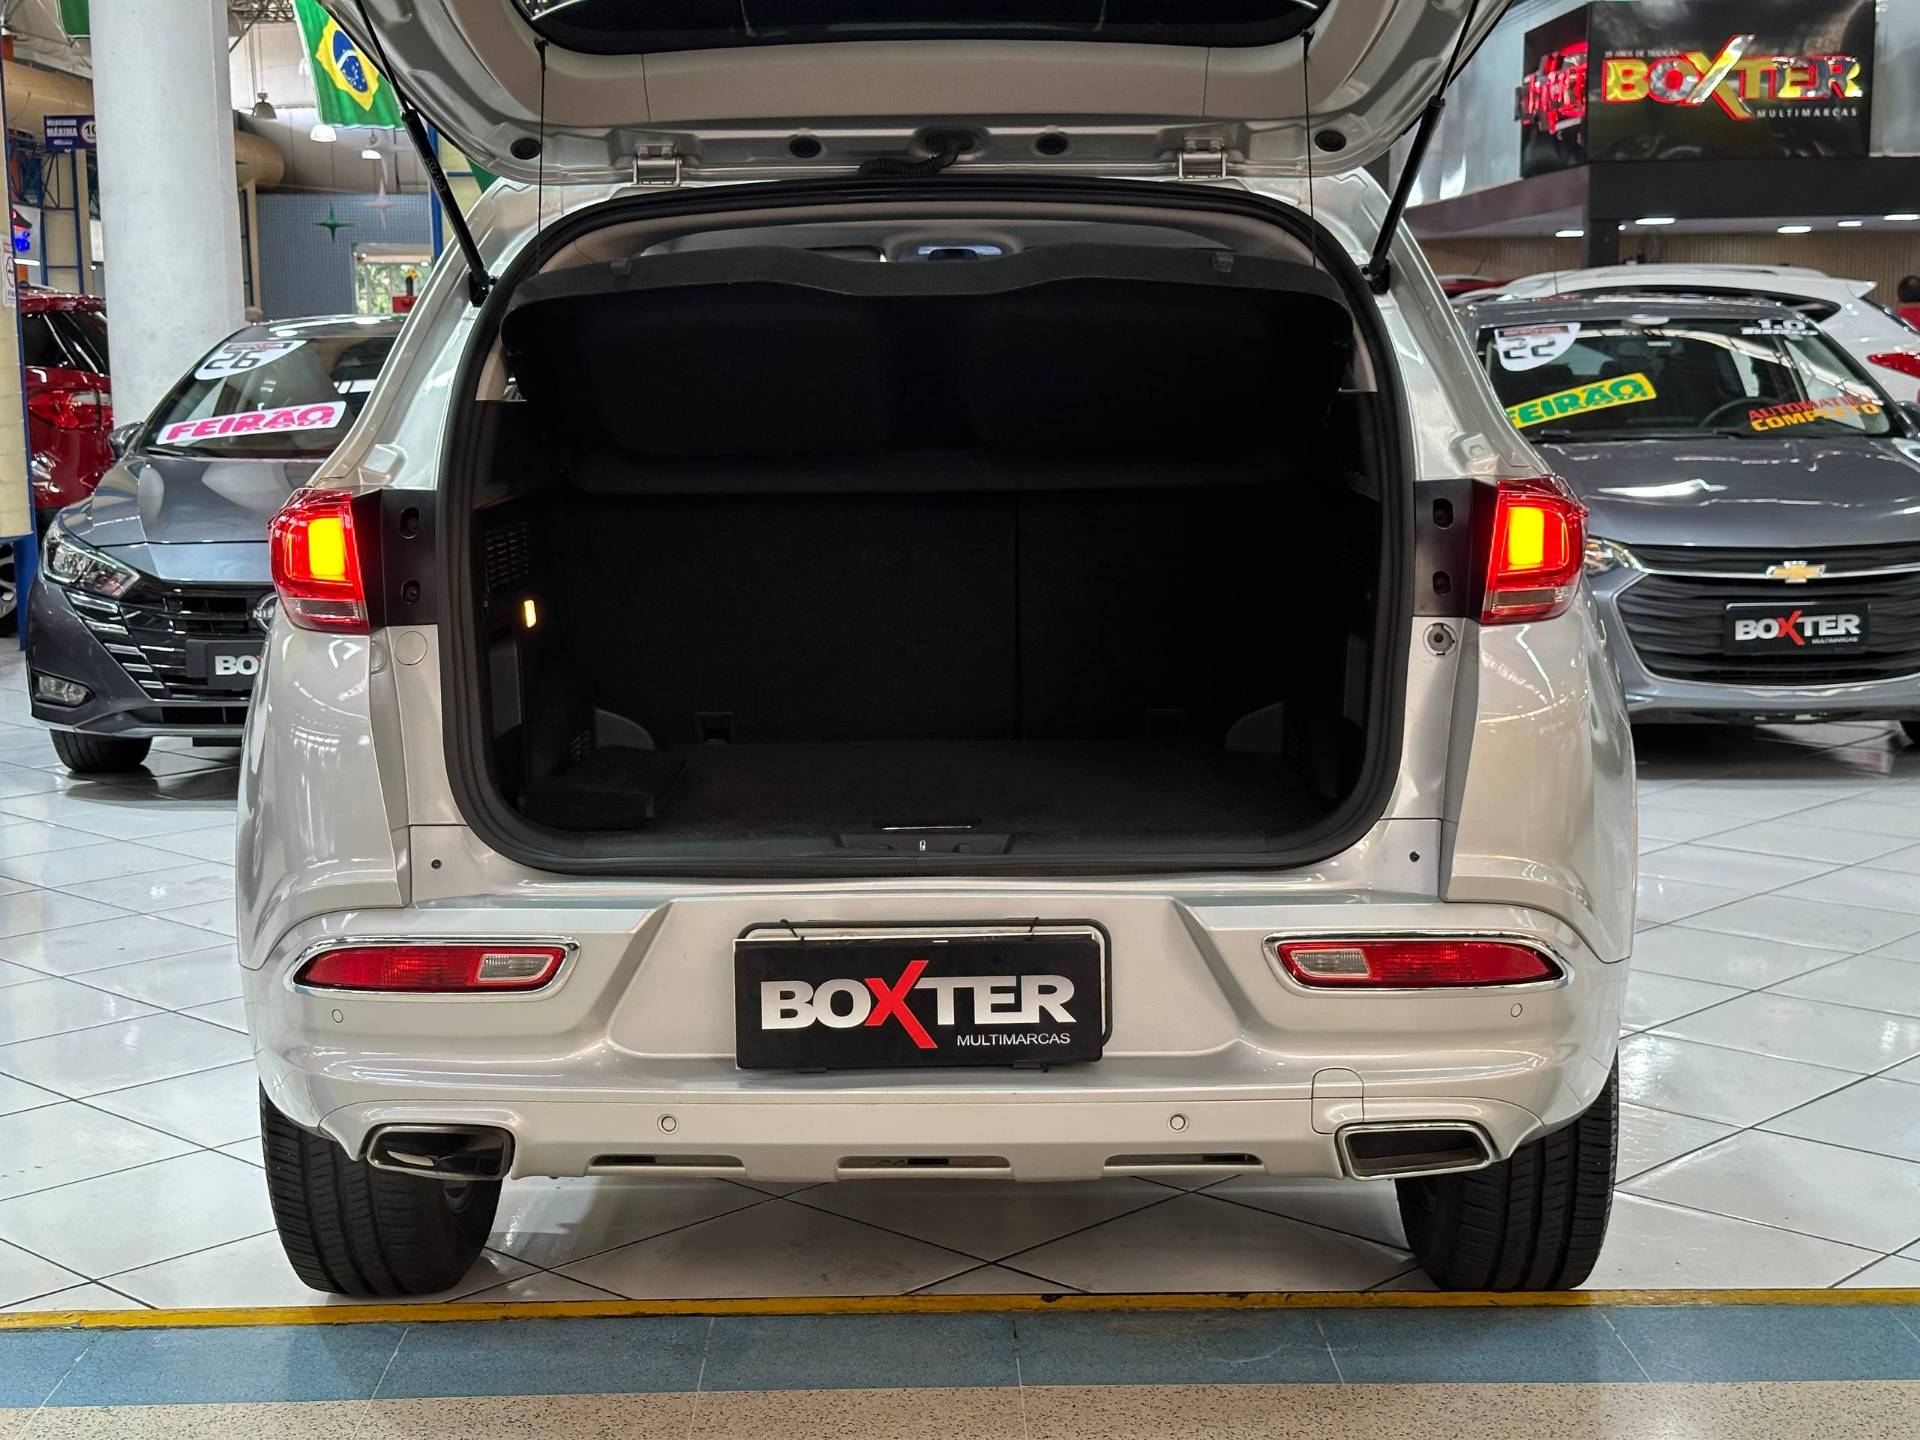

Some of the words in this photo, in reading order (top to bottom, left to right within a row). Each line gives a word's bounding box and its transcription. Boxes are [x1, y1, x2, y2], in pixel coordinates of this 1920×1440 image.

[1602, 35, 1863, 121] BOXTER
[1757, 107, 1857, 118] MULTIMARCAS
[204, 349, 261, 370] 26
[1502, 336, 1556, 360] 22
[1751, 403, 1880, 432] COMPLETO
[1735, 609, 1861, 645] BOXTER
[215, 655, 262, 675] BO
[760, 960, 1077, 1049] BOXTER
[957, 1032, 1071, 1047] MULTIMARCAS
